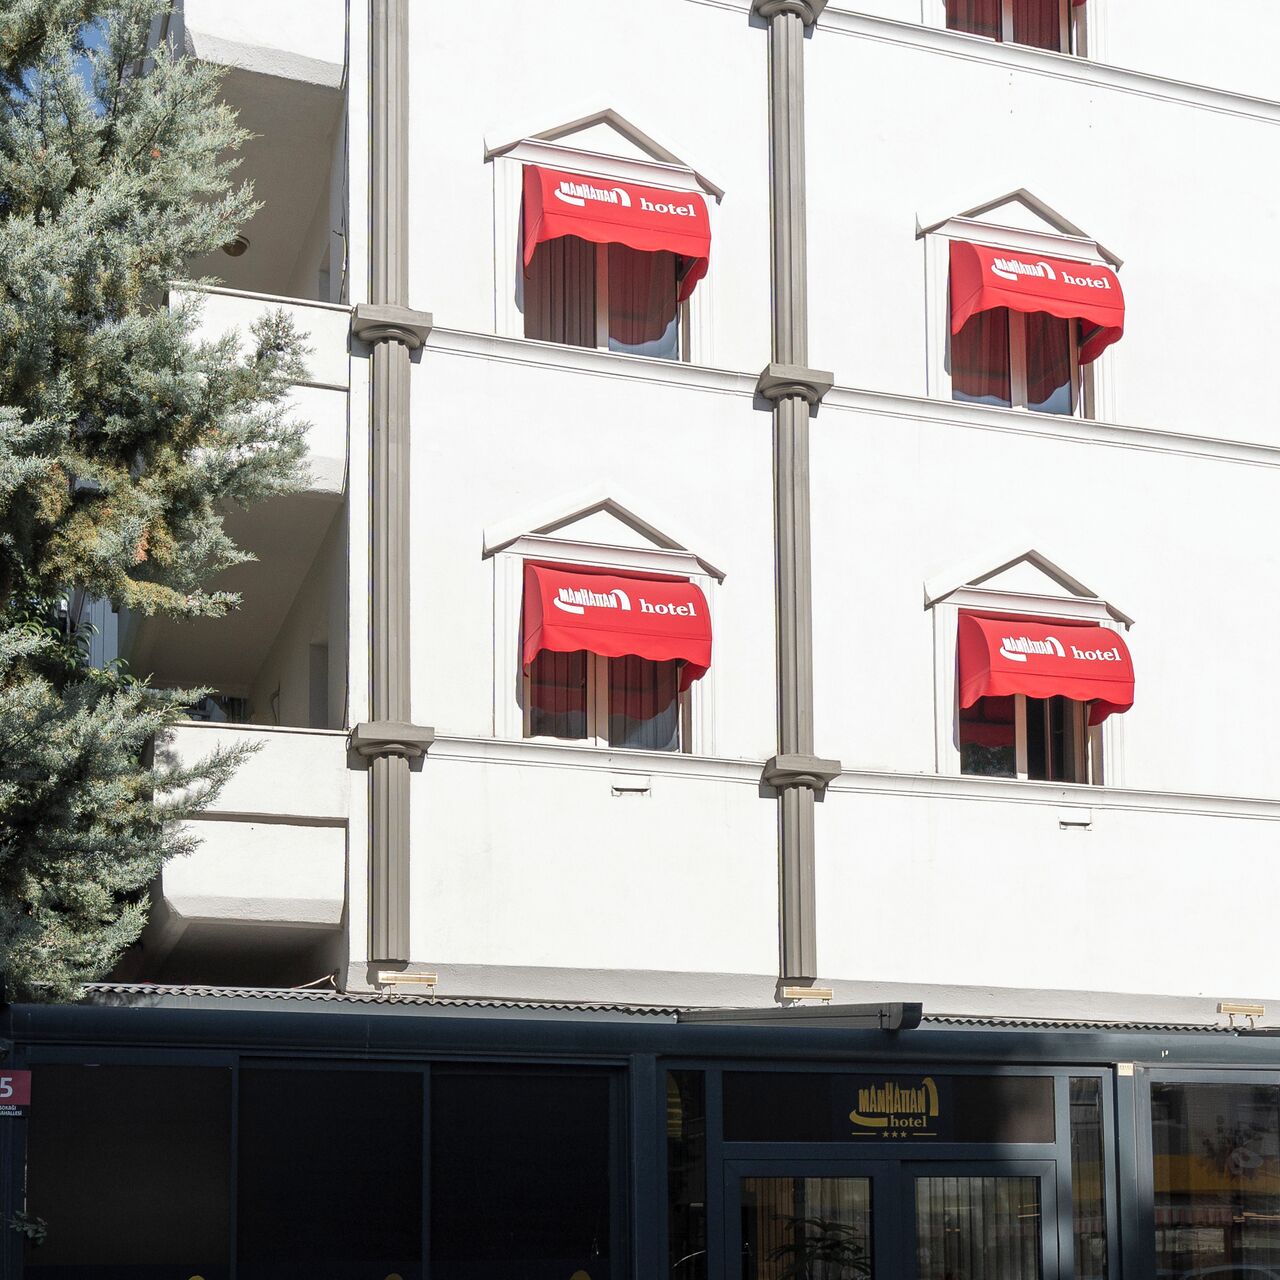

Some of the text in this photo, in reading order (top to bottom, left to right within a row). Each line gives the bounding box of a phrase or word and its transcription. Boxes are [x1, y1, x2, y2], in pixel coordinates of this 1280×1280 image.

[559, 181, 696, 217] MANHATTAN hotel
[1061, 271, 1111, 289] hotel
[558, 587, 697, 616] MANHATTAN hotel
[1001, 636, 1122, 661] MANHATTAN hotel
[858, 1081, 926, 1113] MANHATTAN
[890, 1115, 928, 1128] hotel
